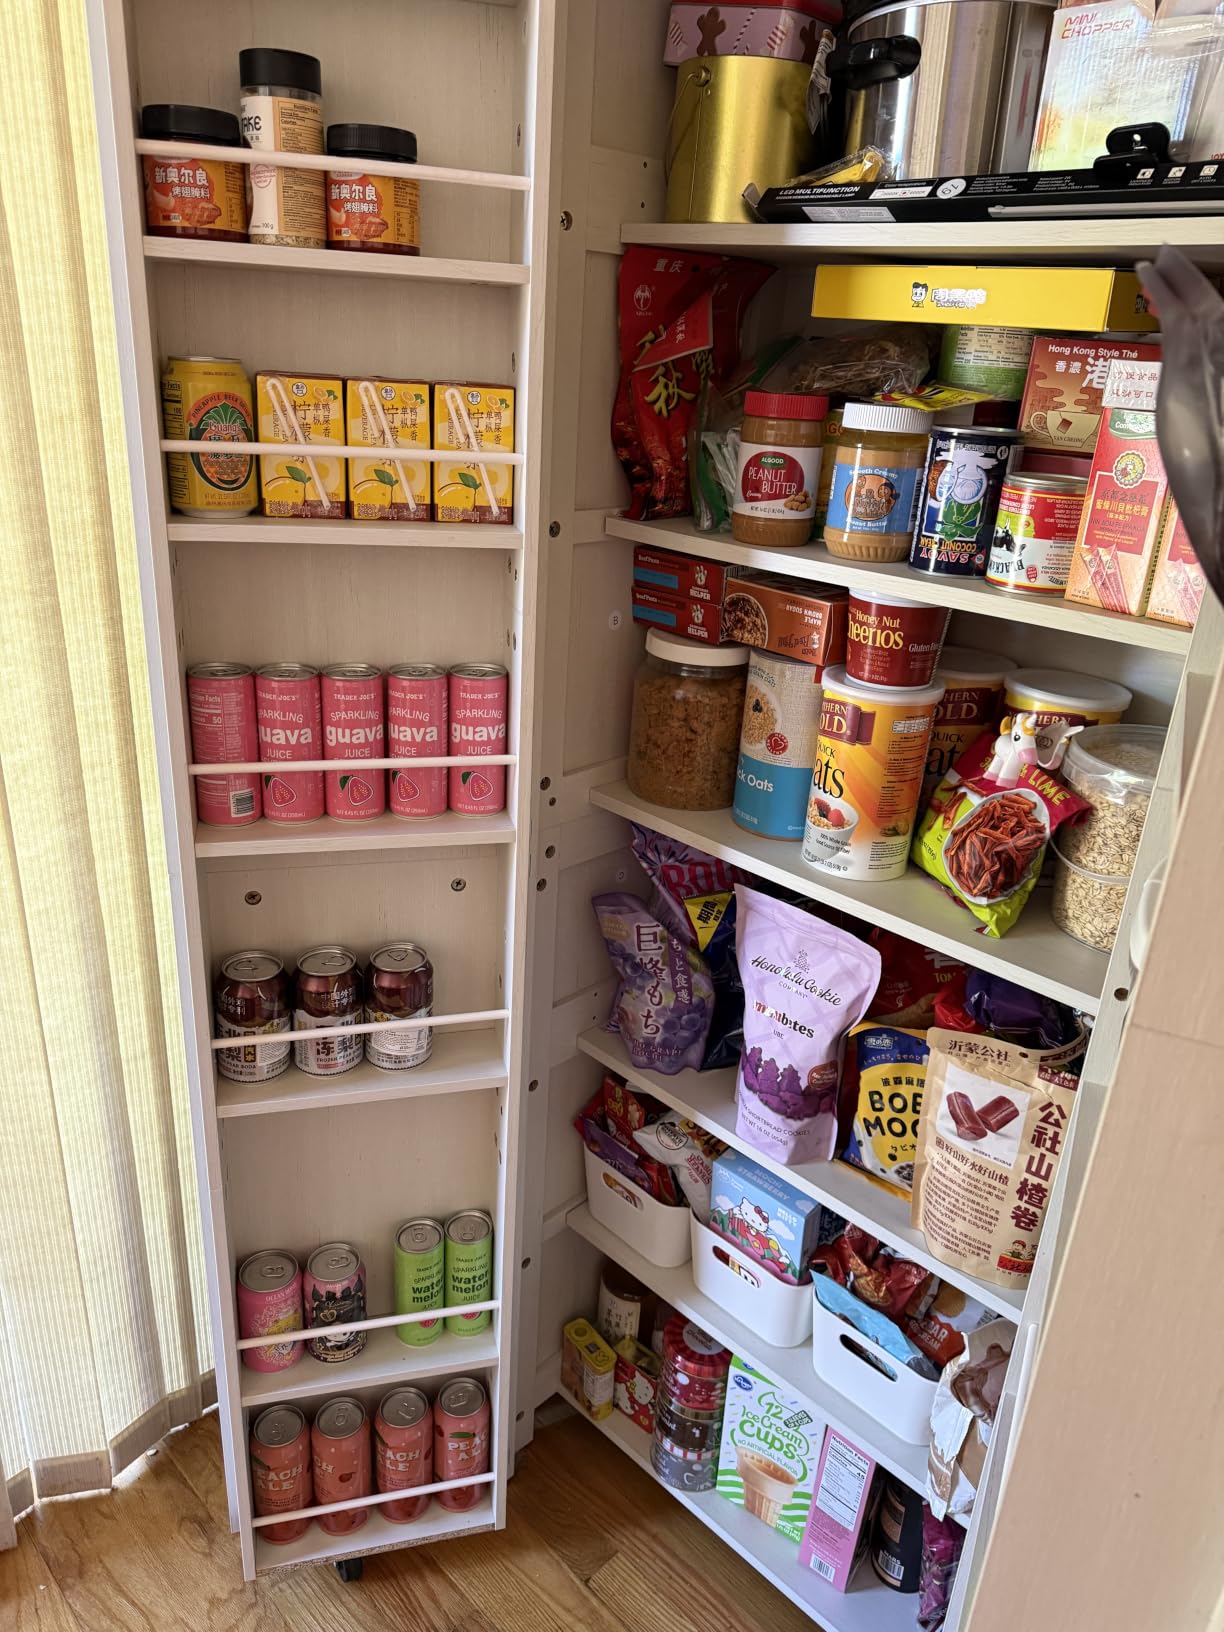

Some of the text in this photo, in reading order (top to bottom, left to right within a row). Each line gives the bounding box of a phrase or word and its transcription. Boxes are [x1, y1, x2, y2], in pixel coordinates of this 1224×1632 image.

[1064, 12, 1098, 27] MINI
[1061, 19, 1134, 40] CHOPPER
[154, 166, 210, 187] 新奥尔良
[331, 183, 378, 202] 新奥尔良
[795, 186, 861, 195] MULTIFUNCTION
[654, 258, 684, 273] 重庆
[1048, 344, 1138, 359] Hong Kong Style Thé
[1055, 359, 1081, 375] 香濃
[191, 394, 221, 418] PINEAPPLE
[761, 456, 784, 464] ALGOOD
[748, 466, 786, 482] PEANUT
[849, 467, 874, 475] Sooth
[762, 481, 797, 495] BUTTER
[941, 542, 976, 553] COCONUT
[689, 588, 711, 601] HELPER
[804, 616, 821, 626] MAPLE
[856, 611, 901, 628] Honey Nut
[687, 626, 709, 639] HELPER
[847, 619, 904, 650] heerios
[389, 690, 405, 699] RADER
[460, 692, 482, 700] TRADER
[943, 689, 980, 702] HERN
[212, 716, 222, 724] 50
[258, 709, 304, 723] PARKLING
[330, 710, 379, 722] SPARKLING
[389, 706, 430, 722] PARKLING
[456, 709, 503, 719] SPARKLING
[936, 702, 978, 720] OLD
[389, 722, 438, 742] uava
[451, 722, 506, 743] guava
[819, 714, 848, 735] OLD
[259, 726, 312, 745] uava
[326, 723, 384, 747] guava
[267, 748, 293, 759] JUICE
[344, 748, 371, 758] JUICE
[394, 746, 417, 756] JUICE
[466, 745, 492, 755] JUICE
[747, 774, 774, 793] Oats
[814, 757, 846, 800] ats
[1027, 768, 1072, 807] LIME
[635, 923, 667, 1036] 巨峰もち
[671, 937, 691, 1005] ちっと食感
[751, 955, 842, 1007] Honolulu Cookie
[773, 1029, 785, 1041] UBE
[948, 1039, 1012, 1063] 沂蒙公社
[868, 1090, 923, 1115] BOB
[747, 1108, 783, 1134] SHORTBREAD
[863, 1115, 920, 1138] MOC
[944, 1142, 1010, 1187] 好山好水好山楂
[1010, 1101, 1068, 1233] 公社山楂卷
[737, 1166, 791, 1202] STRAWBERRY
[754, 1169, 784, 1189] MOCHI
[451, 1270, 489, 1285] water
[412, 1286, 444, 1304] melo
[452, 1280, 489, 1294] melon
[765, 1402, 784, 1421] 12
[741, 1405, 804, 1451] Ice Cream
[738, 1420, 799, 1461] Cups
[746, 1441, 777, 1461] ARTIFICIAL
[828, 1450, 848, 1467] Calories
[831, 1435, 870, 1466] Nutrition Facts
[256, 1463, 304, 1482] EACH
[856, 1472, 866, 1480] 45
